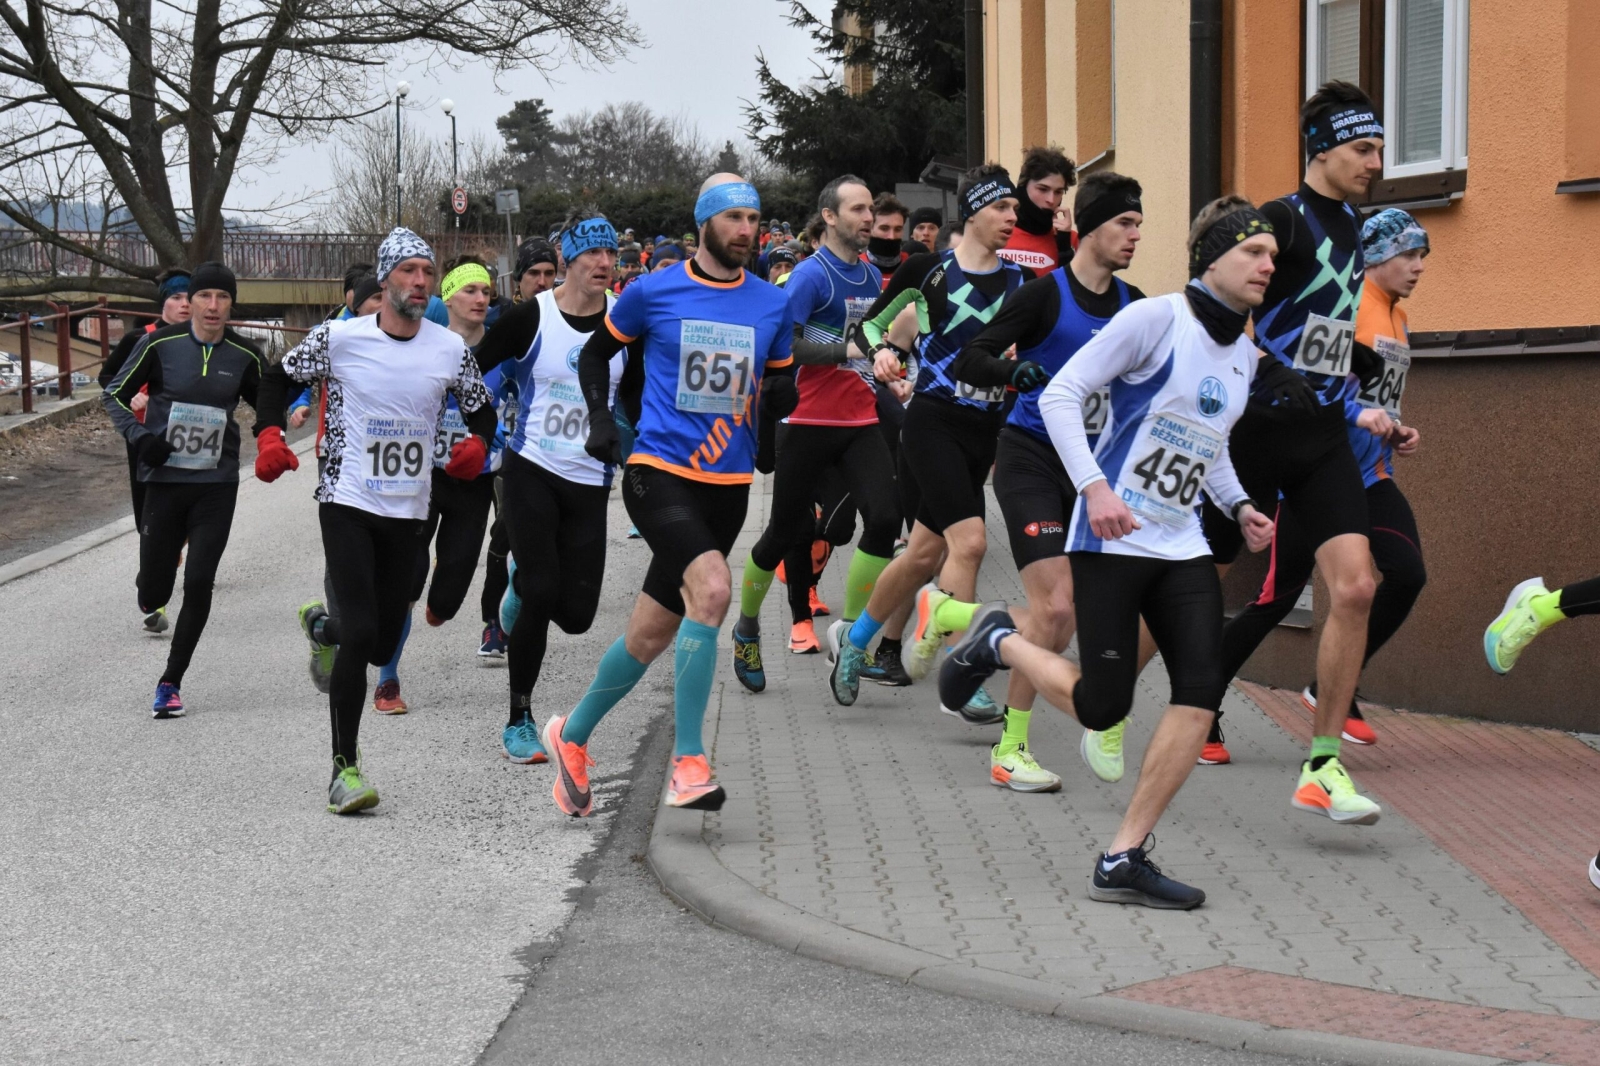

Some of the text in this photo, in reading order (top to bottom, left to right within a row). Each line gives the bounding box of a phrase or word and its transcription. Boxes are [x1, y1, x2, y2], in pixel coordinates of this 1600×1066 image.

[1332, 111, 1374, 130] HRADECKÝ
[968, 181, 998, 203] HRADECKÝ
[684, 324, 715, 335] ZIMNÍ
[683, 334, 726, 347] BĚŽECKÁ
[729, 339, 752, 349] LIGA
[1302, 324, 1353, 373] 647
[1377, 339, 1396, 351] ZIMNÍ
[685, 350, 750, 397] 651
[551, 382, 577, 392] ZIMNÍ
[549, 390, 585, 404] BĚŽECKÁ
[173, 406, 195, 414] ZIMNÍ
[171, 413, 204, 423] BĚŽECKÁ
[207, 417, 224, 426] LIGA
[367, 418, 395, 428] ZIMNÍ
[1156, 416, 1189, 437] ZIMNÍ
[169, 424, 221, 457] 654
[366, 427, 428, 437] BĚŽECKÁ LIGA
[1150, 426, 1194, 452] BĚŽECKÁ
[1196, 444, 1216, 460] LIGA
[366, 441, 424, 477] 169
[1133, 446, 1206, 506] 456
